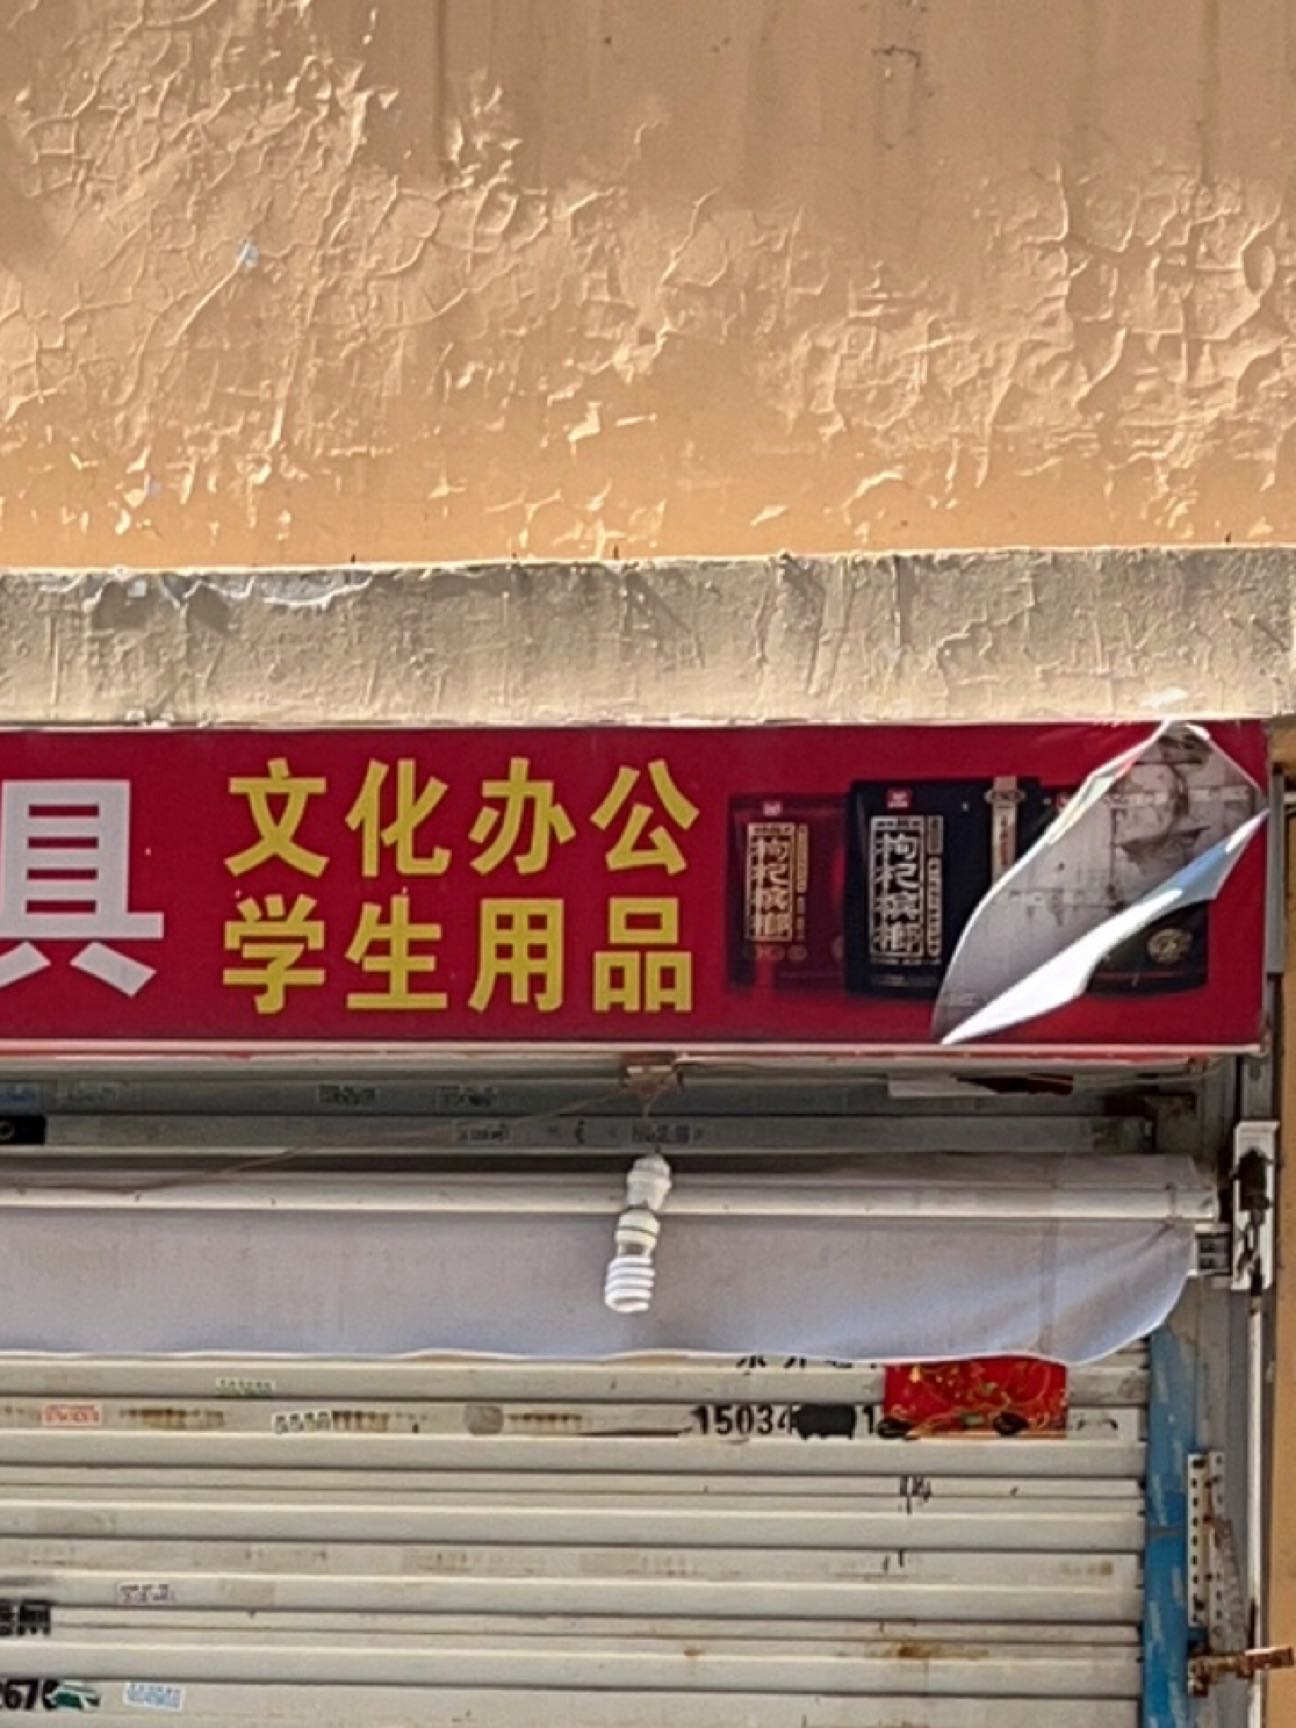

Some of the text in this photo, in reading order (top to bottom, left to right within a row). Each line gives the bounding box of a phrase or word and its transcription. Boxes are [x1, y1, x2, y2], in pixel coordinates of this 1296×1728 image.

[224, 757, 699, 878] 文化办公
[222, 893, 693, 1014] 学生用品
